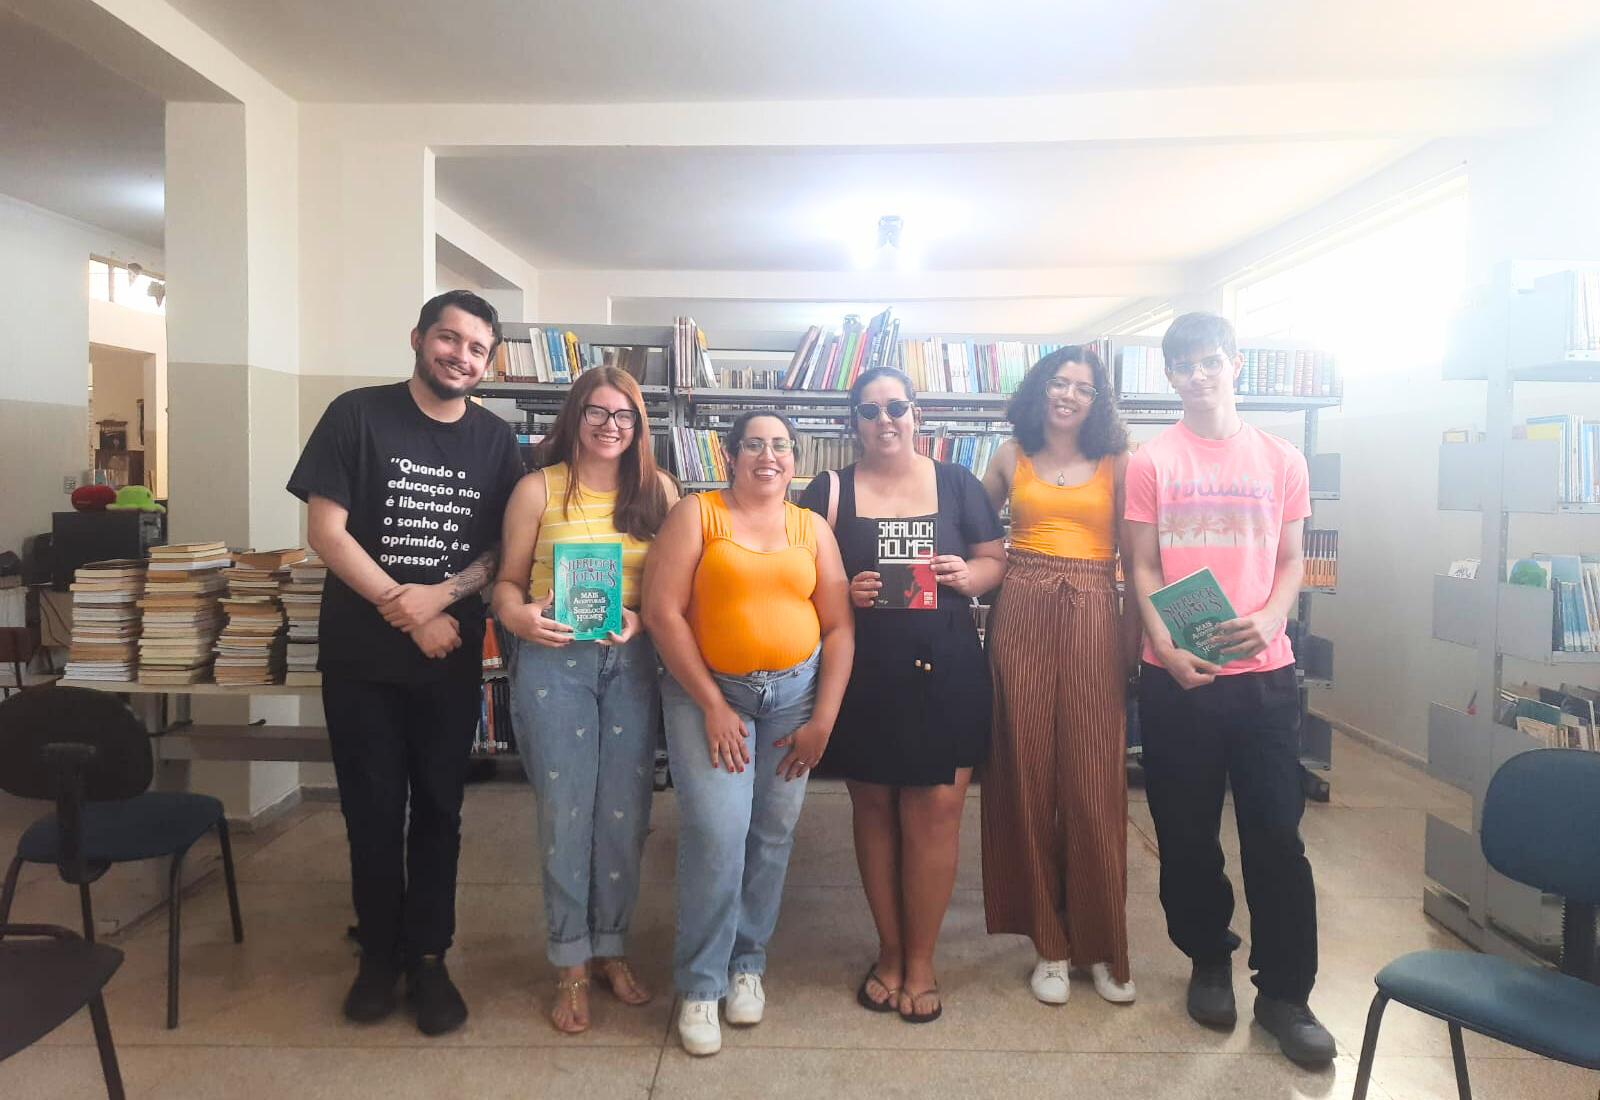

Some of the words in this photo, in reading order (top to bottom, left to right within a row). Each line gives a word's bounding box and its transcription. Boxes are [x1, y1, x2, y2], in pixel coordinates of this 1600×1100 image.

[457, 470, 466, 480] a
[387, 476, 454, 497] educação
[458, 487, 481, 500] não
[385, 495, 395, 507] é
[383, 516, 393, 526] o
[397, 516, 440, 530] sonho
[442, 519, 459, 532] do
[878, 521, 934, 538] SHERLOCK
[381, 533, 448, 551] oprimido,
[451, 539, 459, 551] é
[878, 539, 934, 558] HOLMES
[560, 556, 617, 575] SHERLOCK
[565, 571, 617, 588] HOLMES
[573, 605, 606, 614] SHERLOCK
[576, 614, 603, 622] HOLMES
